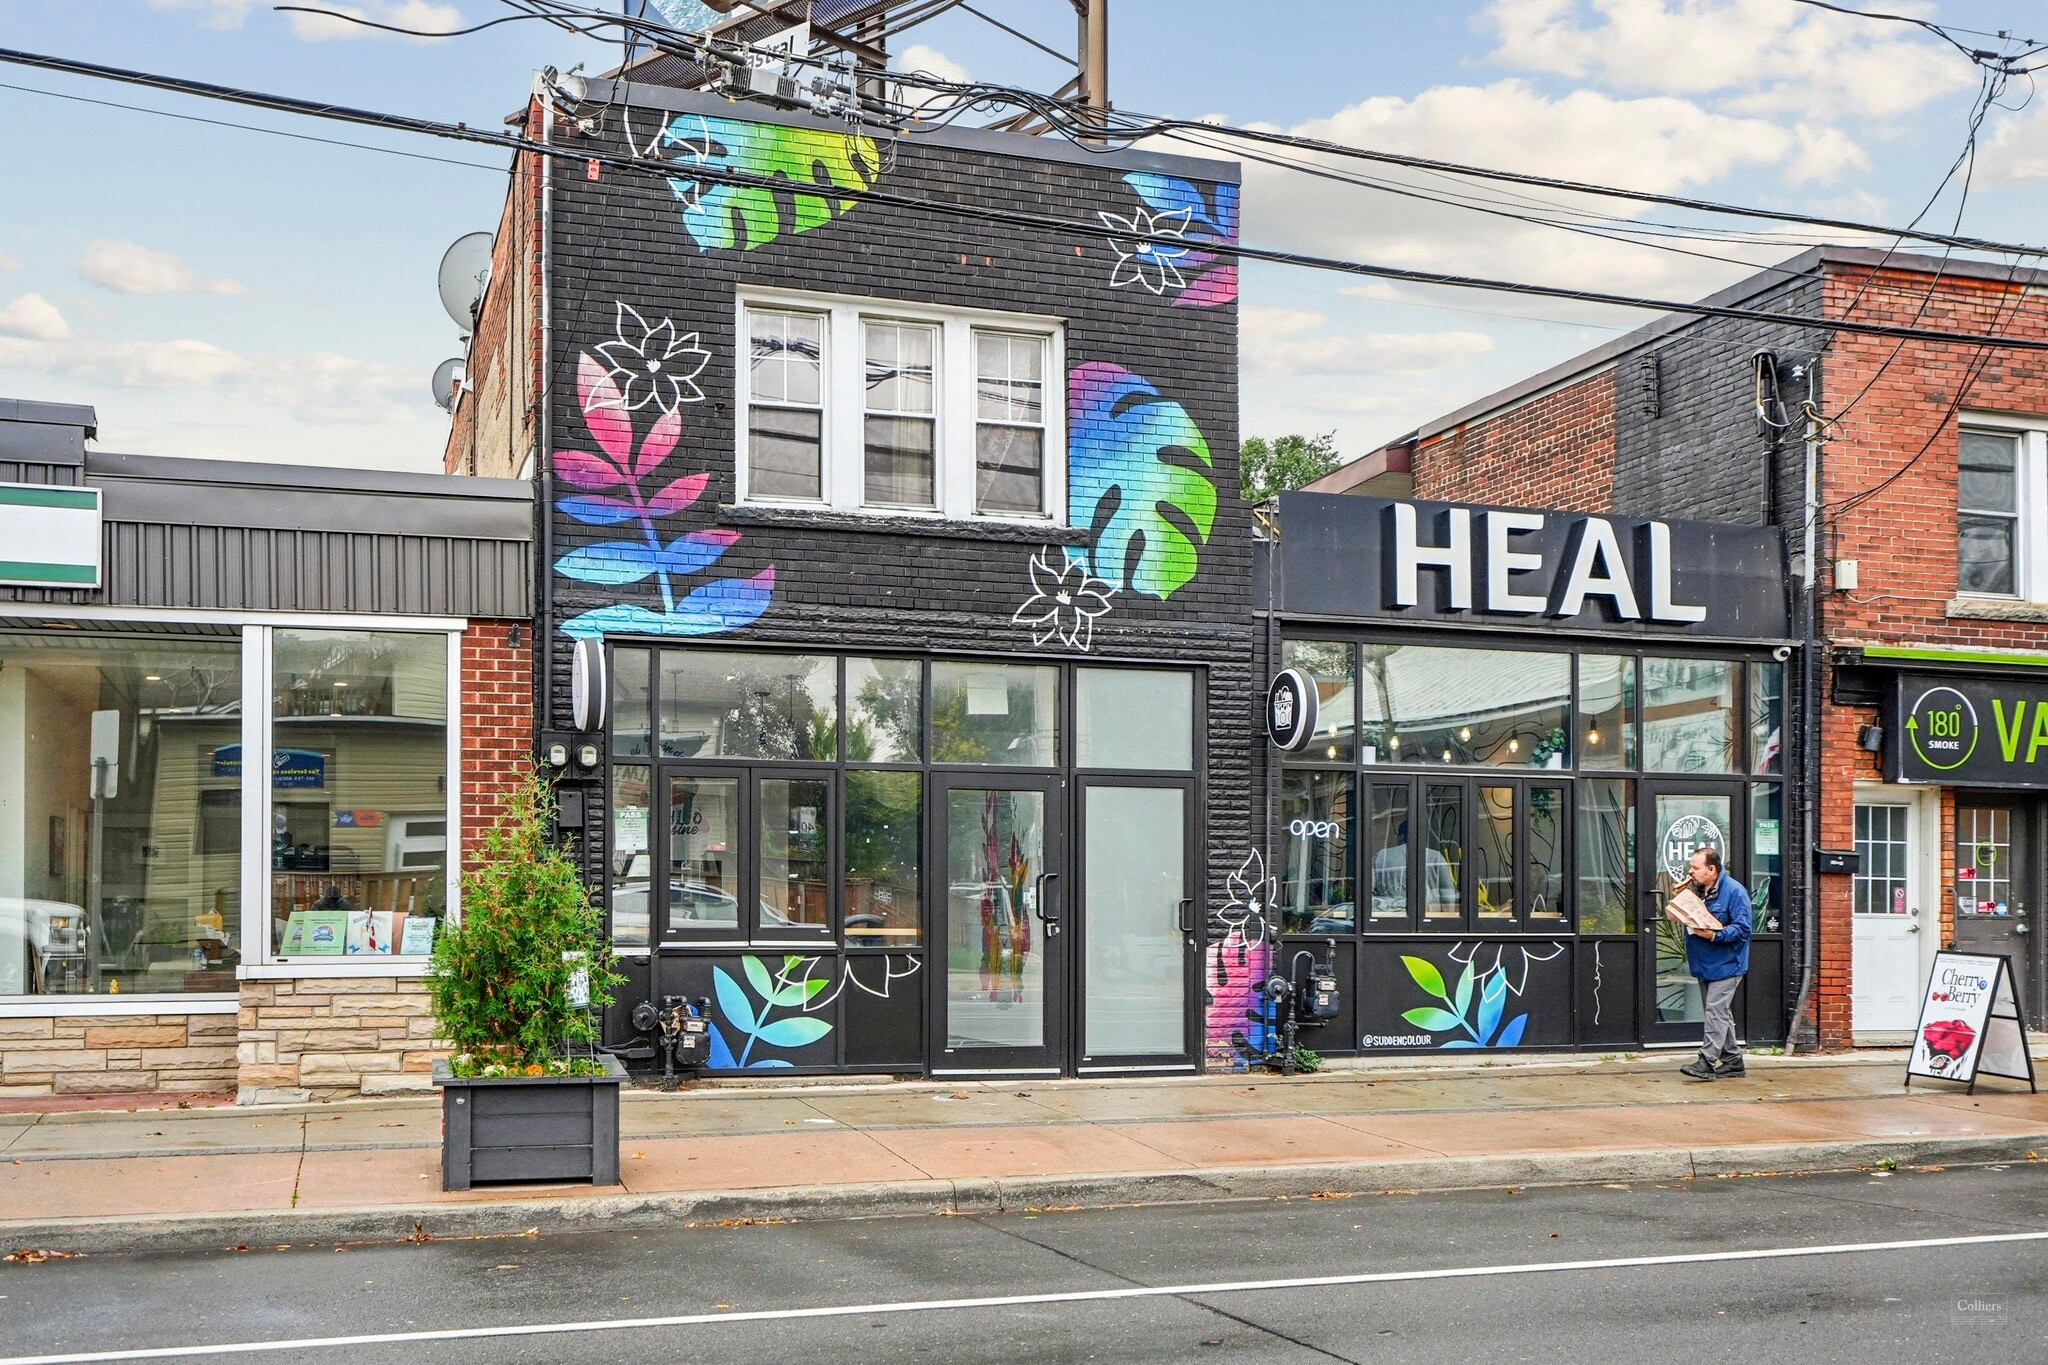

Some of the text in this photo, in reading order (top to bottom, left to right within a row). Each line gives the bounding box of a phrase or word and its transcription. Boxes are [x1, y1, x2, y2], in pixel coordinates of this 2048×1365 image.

[1393, 502, 1708, 622] HEAL
[1927, 740, 1960, 750] SMOKE
[620, 811, 642, 819] PASS
[1290, 819, 1340, 841] open
[1669, 841, 1716, 861] HE
[1941, 968, 1985, 991] Cherry
[1947, 985, 1981, 1008] Berry
[1362, 1034, 1432, 1047] @SUDDENCOLOUR
